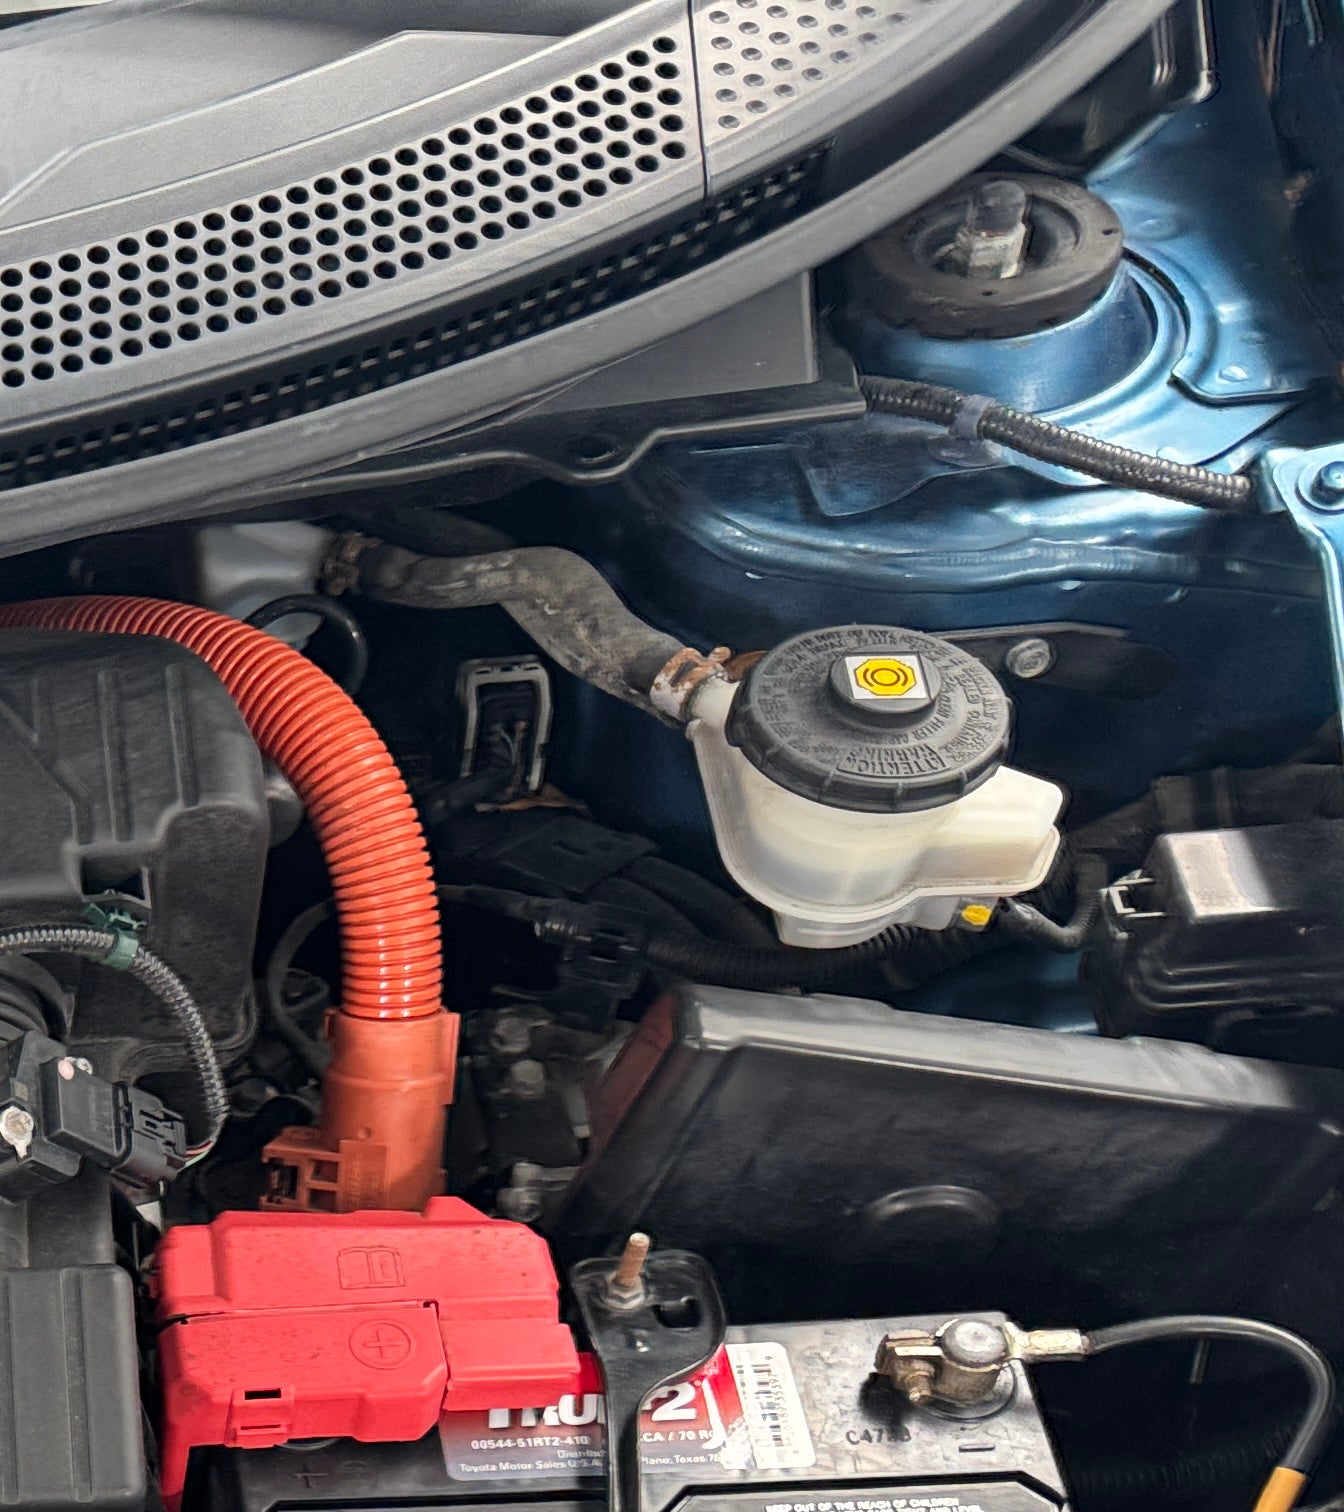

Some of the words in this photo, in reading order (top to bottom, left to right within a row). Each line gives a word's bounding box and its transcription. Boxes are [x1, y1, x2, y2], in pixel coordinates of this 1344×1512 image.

[470, 1436, 589, 1450] 00544-51RT2-410
[674, 1454, 706, 1463] Texas
[459, 1463, 497, 1472] Toyota
[499, 1462, 532, 1471] Motor
[536, 1460, 567, 1470] Sales
